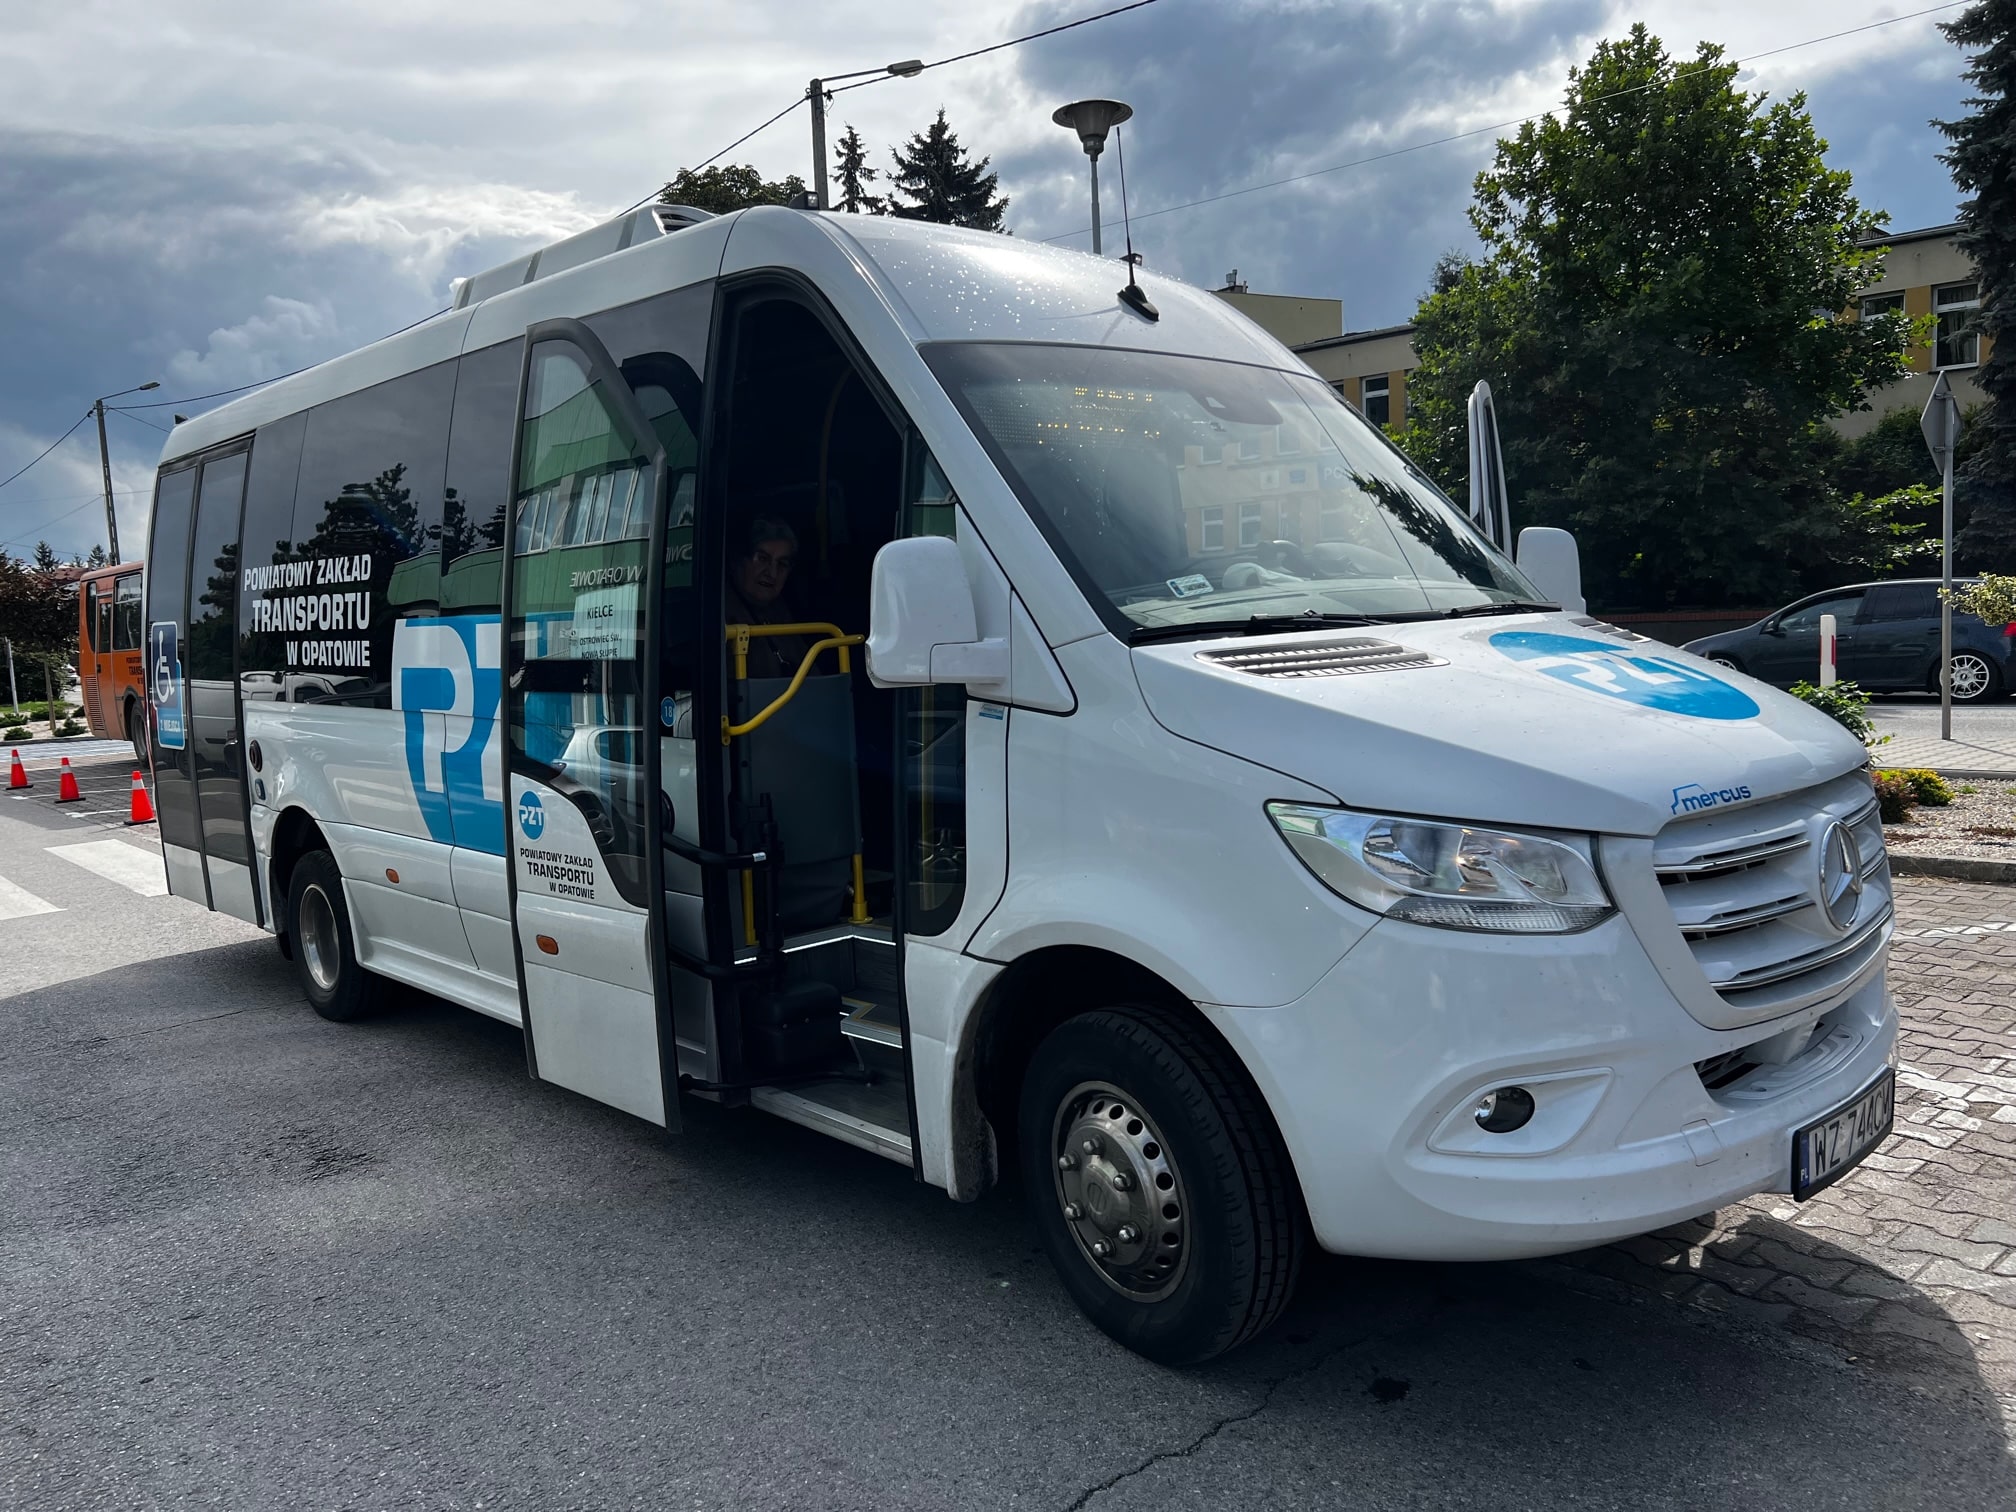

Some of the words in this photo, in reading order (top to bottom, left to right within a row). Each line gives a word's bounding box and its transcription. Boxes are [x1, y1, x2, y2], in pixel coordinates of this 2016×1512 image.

[244, 561, 314, 591] POWIATOWY
[317, 554, 371, 585] ZAKŁAD
[252, 592, 370, 632] TRANSPORTU
[587, 605, 613, 620] KIELCE
[580, 636, 610, 646] OSTROWIEC
[286, 641, 298, 666] W
[301, 640, 370, 667] OPATOWIE
[664, 706, 673, 718] 18
[1680, 784, 1752, 812] mercus
[519, 805, 544, 826] PZT
[520, 848, 562, 862] POWIATOWY
[564, 855, 593, 868] ZAKŁAD
[527, 862, 594, 885] TRANSPORTU
[549, 881, 557, 892] W
[558, 883, 595, 899] OPATOWIE
[1814, 1120, 1840, 1177] WZ
[1800, 1167, 1809, 1181] PL
